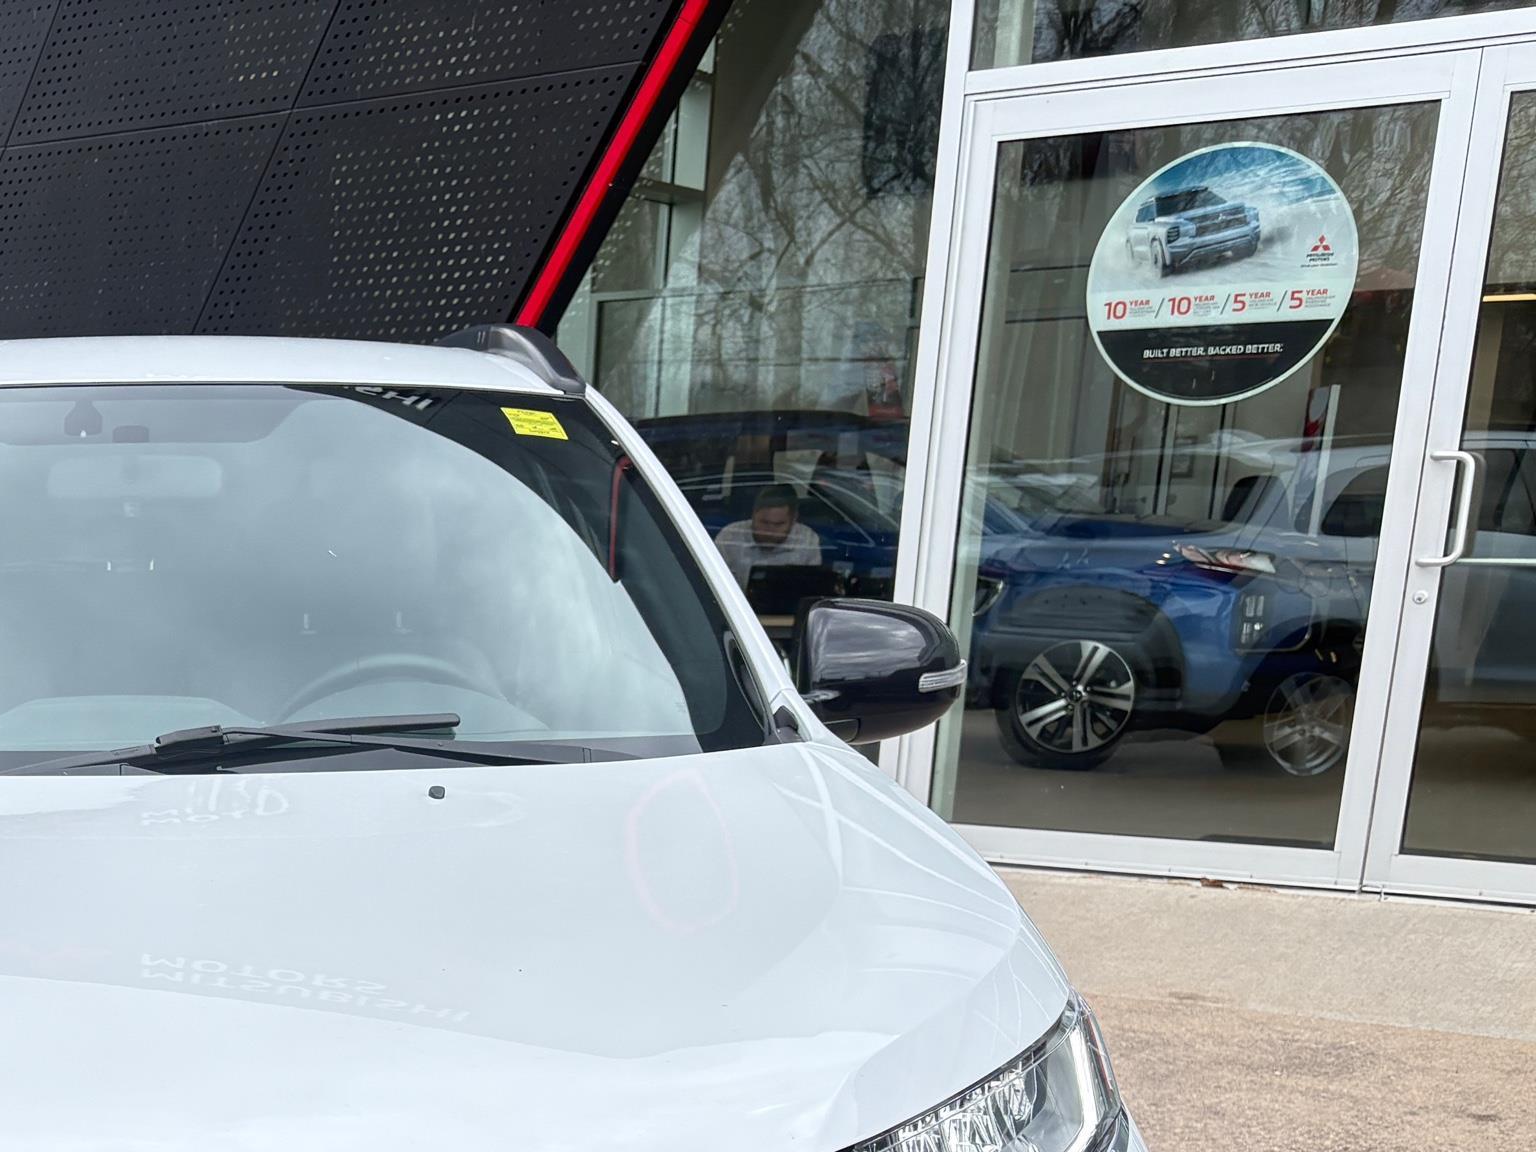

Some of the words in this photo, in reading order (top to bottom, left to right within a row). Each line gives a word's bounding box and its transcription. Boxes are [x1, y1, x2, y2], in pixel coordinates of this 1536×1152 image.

[1249, 291, 1271, 299] YEAR
[1289, 290, 1303, 309] 5
[1305, 288, 1329, 296] YEAR
[1104, 301, 1127, 320] 10
[1129, 299, 1150, 307] YEAR
[1168, 296, 1192, 316] 10
[1232, 293, 1246, 312] 5
[1143, 348, 1168, 358] BUILT
[1207, 345, 1244, 355] BACKED
